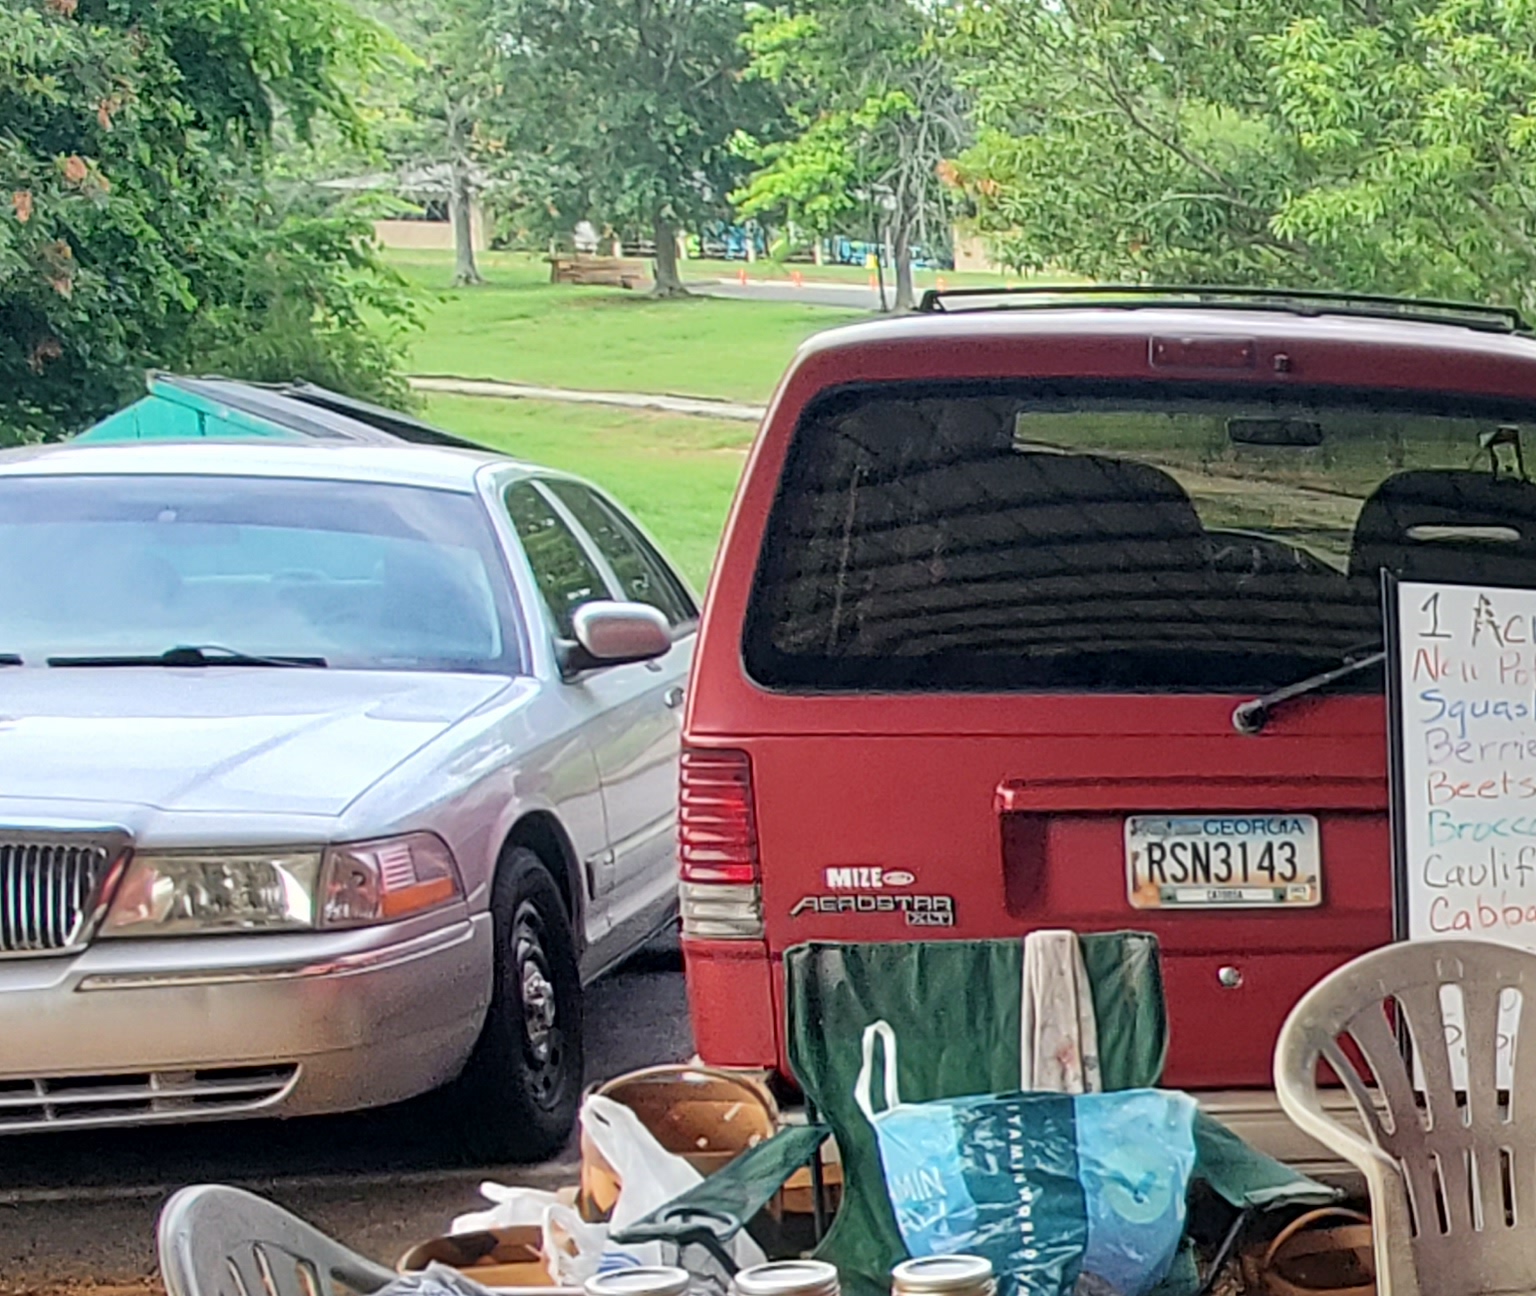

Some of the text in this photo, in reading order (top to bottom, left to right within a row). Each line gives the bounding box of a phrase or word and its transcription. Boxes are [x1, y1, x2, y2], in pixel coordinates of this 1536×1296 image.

[1419, 592, 1451, 637] 1
[1428, 770, 1536, 806] Beets
[1203, 818, 1305, 836] GEORGIA
[1146, 841, 1299, 884] RSN3143
[826, 866, 884, 889] MIZE
[789, 894, 953, 917] AEROSTAR
[907, 911, 953, 926] XLT
